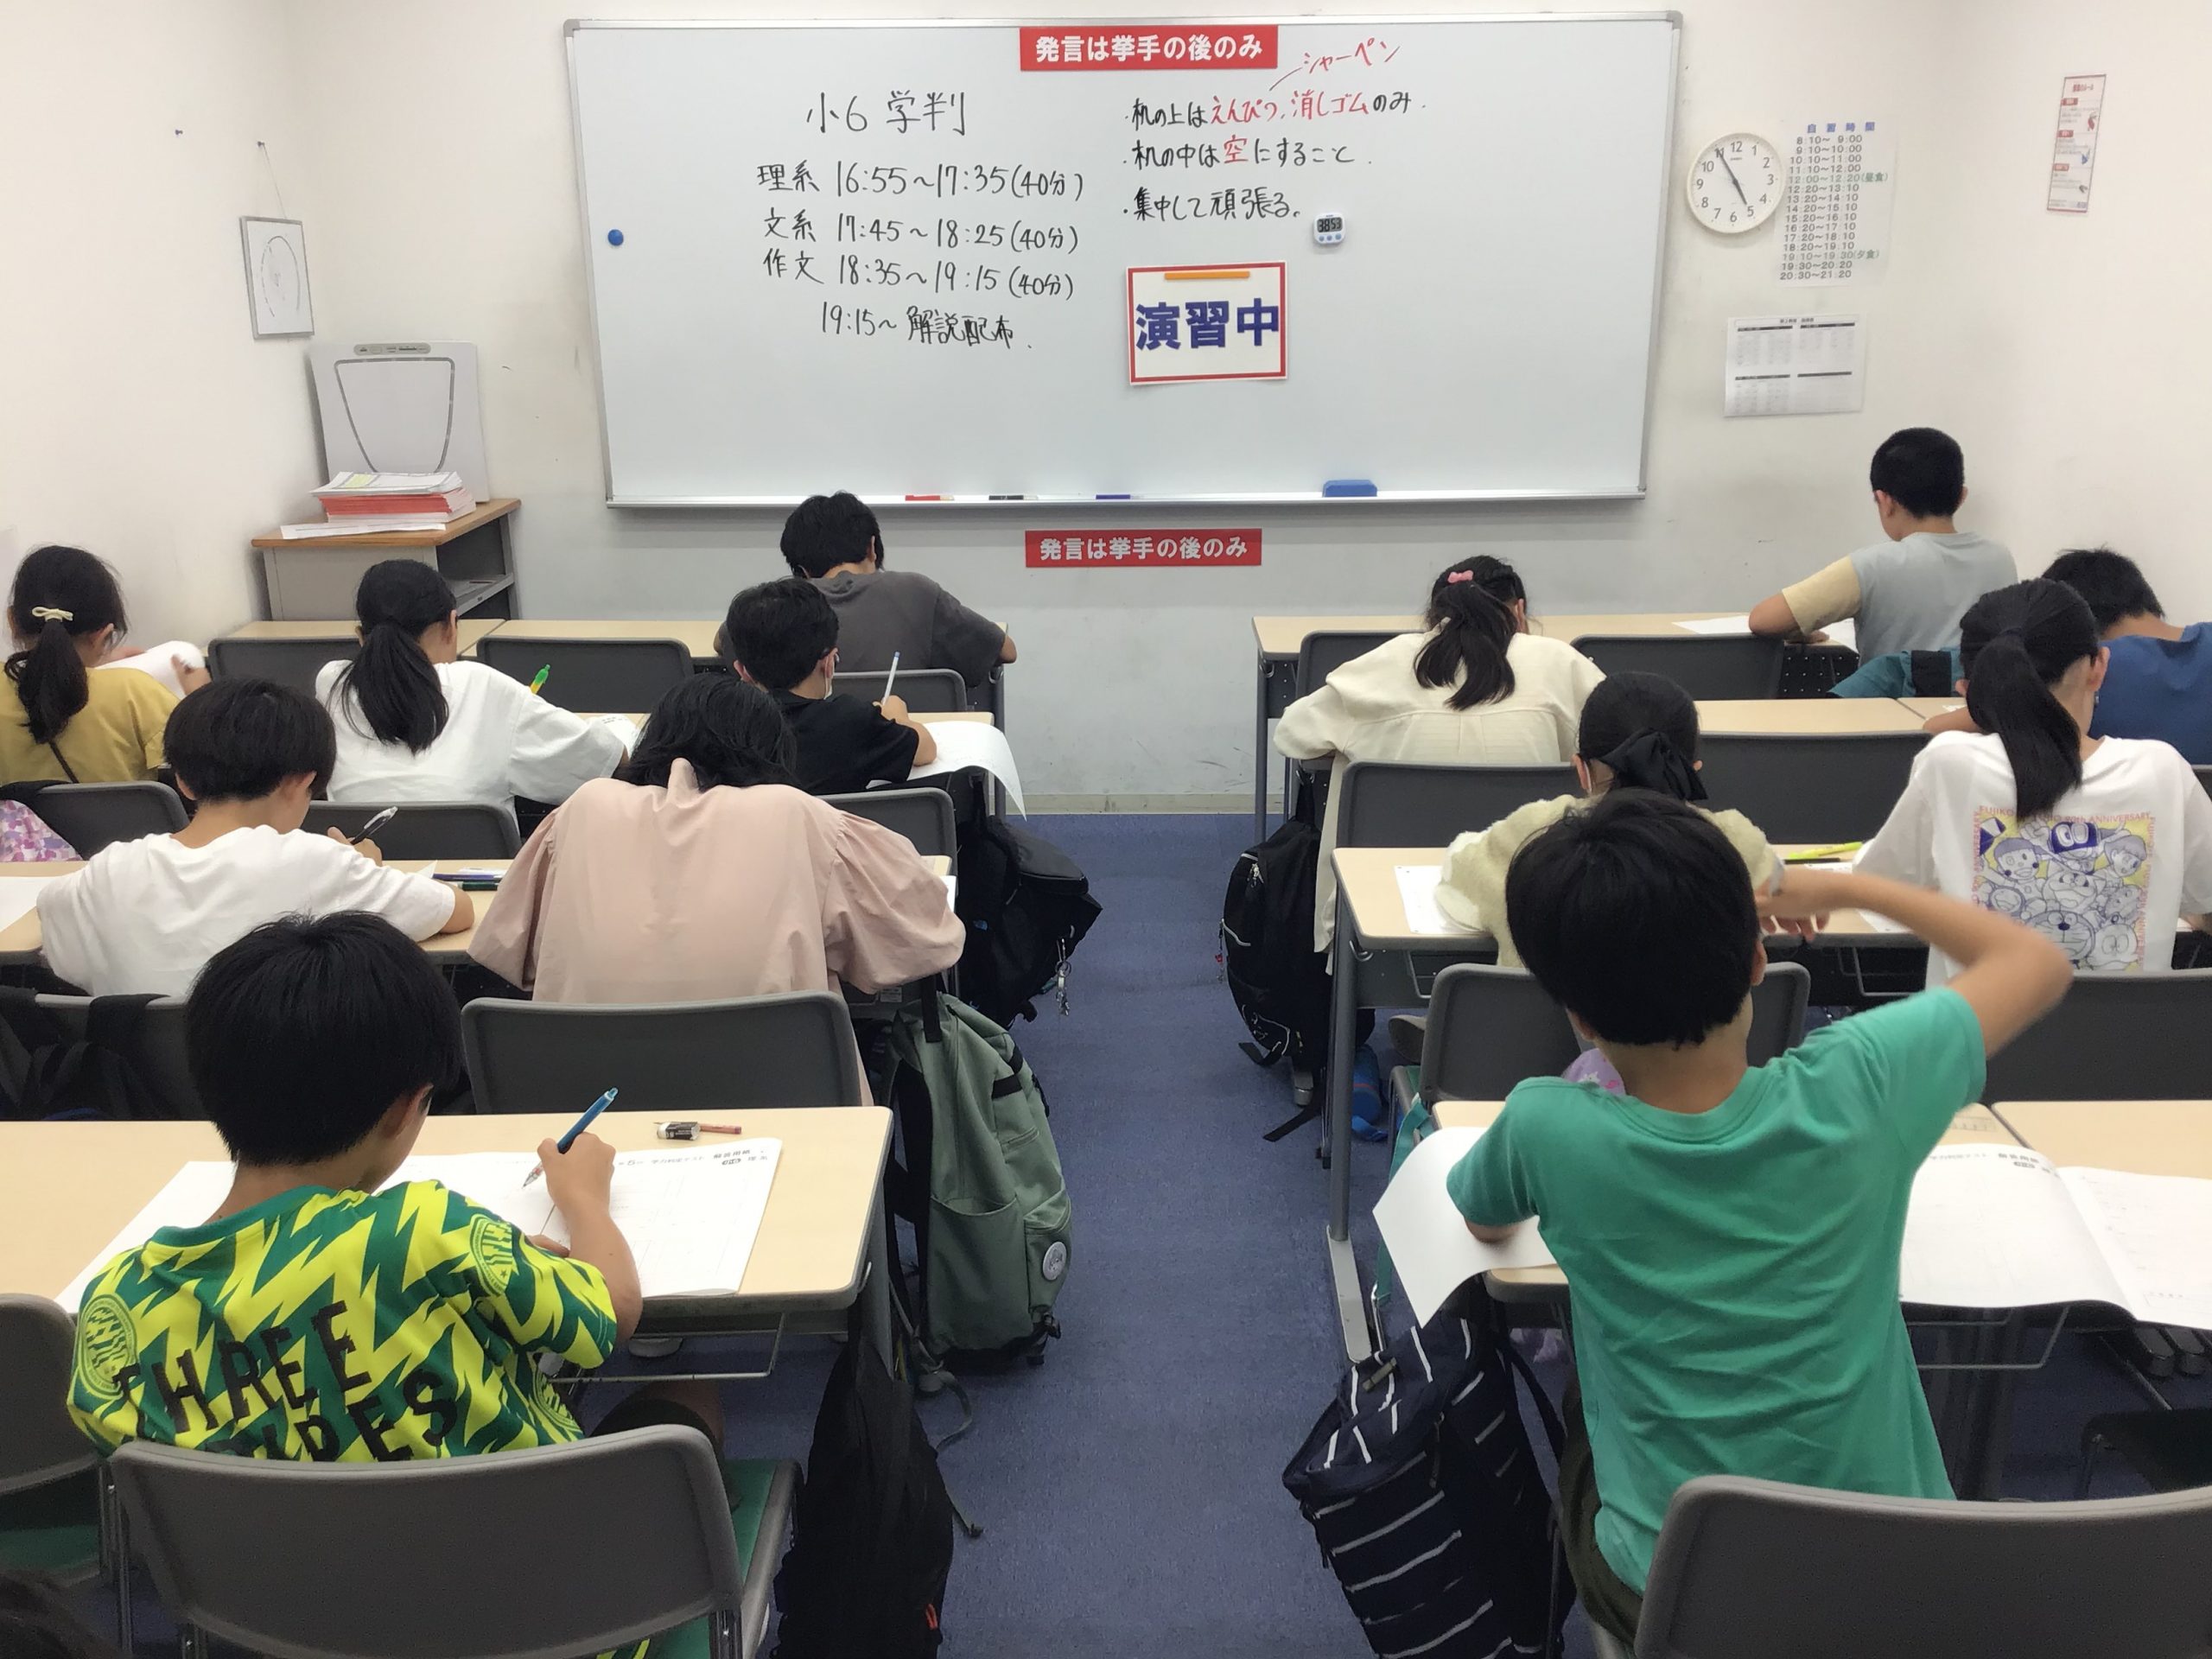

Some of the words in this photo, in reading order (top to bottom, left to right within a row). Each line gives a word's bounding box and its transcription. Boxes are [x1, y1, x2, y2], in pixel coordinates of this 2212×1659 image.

[1036, 35, 1262, 61] 発言は挙手の後のみ
[1302, 37, 1402, 73] シャーペン
[807, 92, 868, 133] 小6
[886, 90, 965, 136] 学判
[1731, 141, 1743, 152] 12
[1752, 145, 1757, 156] 1
[1701, 161, 1714, 172] 10
[1763, 157, 1770, 168] 2
[757, 160, 819, 191] 理系
[1767, 174, 1774, 185] 3
[1696, 178, 1704, 189] 9
[1701, 197, 1708, 207] 8
[1759, 194, 1767, 204] 4
[1714, 208, 1721, 219] 7
[1730, 212, 1737, 222] 6
[1747, 206, 1754, 217] 5
[765, 207, 816, 242] 文系
[763, 248, 824, 284] 作文
[1136, 297, 1280, 350] 演習中
[1039, 537, 1248, 561] 発言は挙手の後のみ
[113, 1300, 372, 1438] THREE
